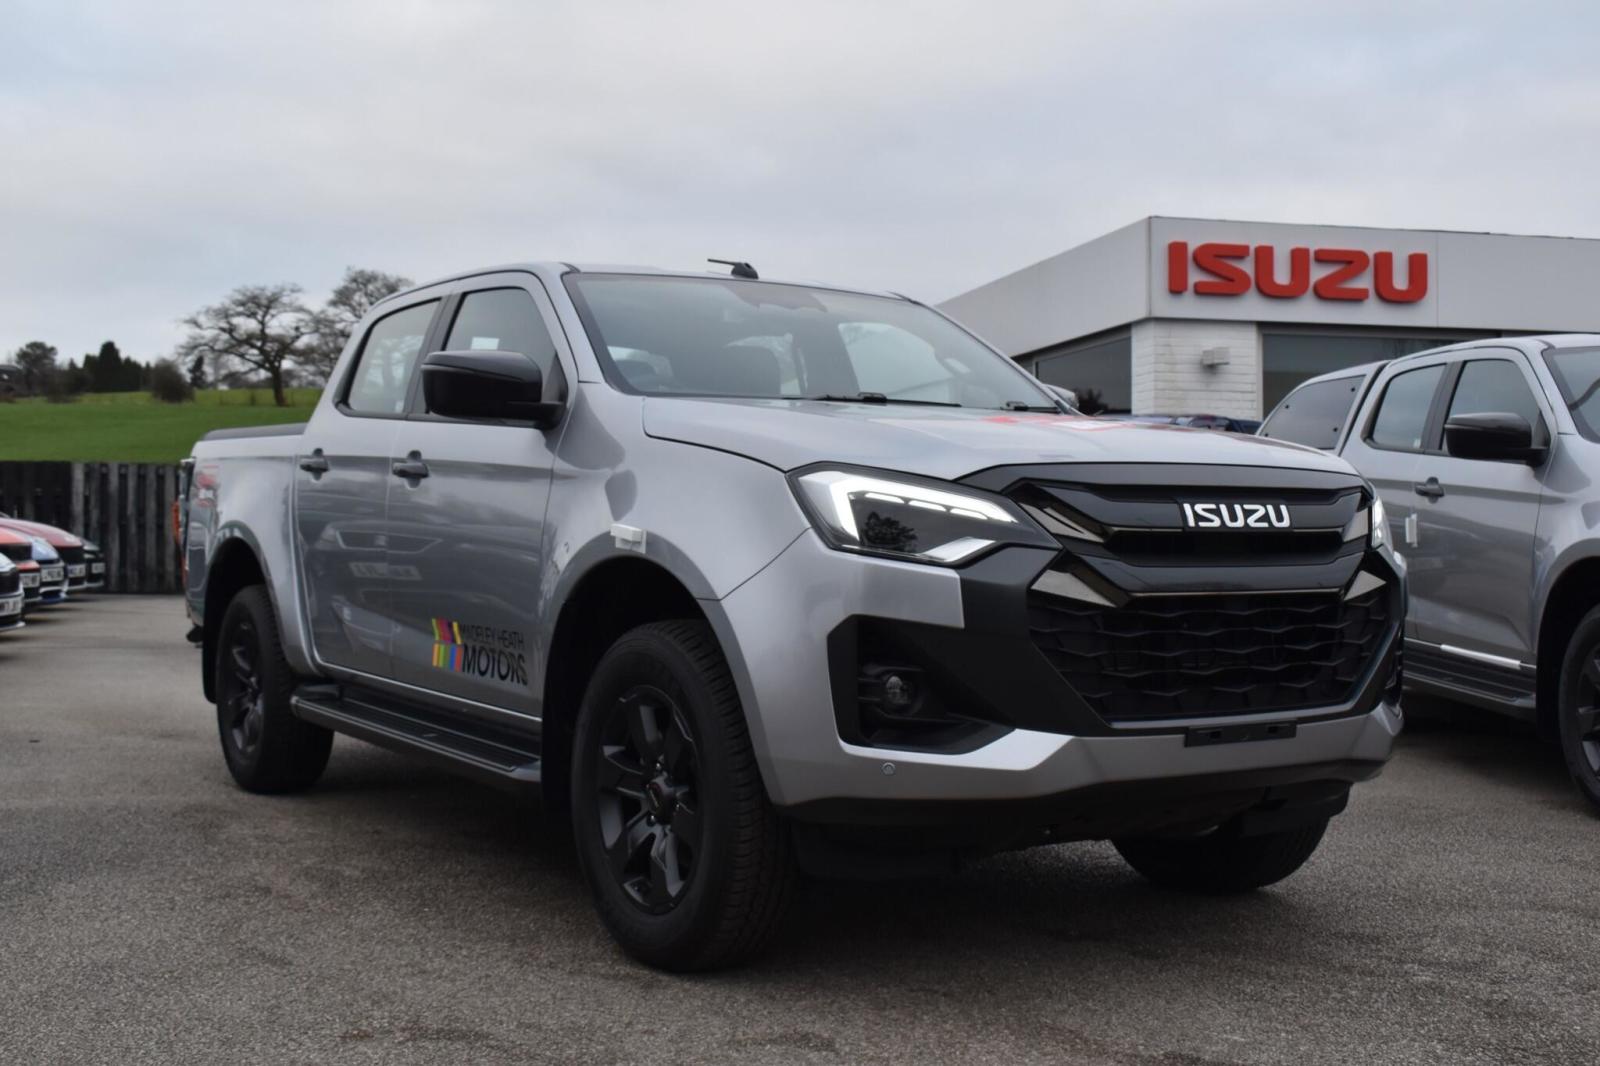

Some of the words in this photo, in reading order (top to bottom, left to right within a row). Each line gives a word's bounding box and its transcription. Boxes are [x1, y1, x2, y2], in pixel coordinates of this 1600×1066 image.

[1168, 241, 1428, 304] ISUZU
[1183, 503, 1291, 528] ISUZU
[462, 643, 528, 686] MOTORS
